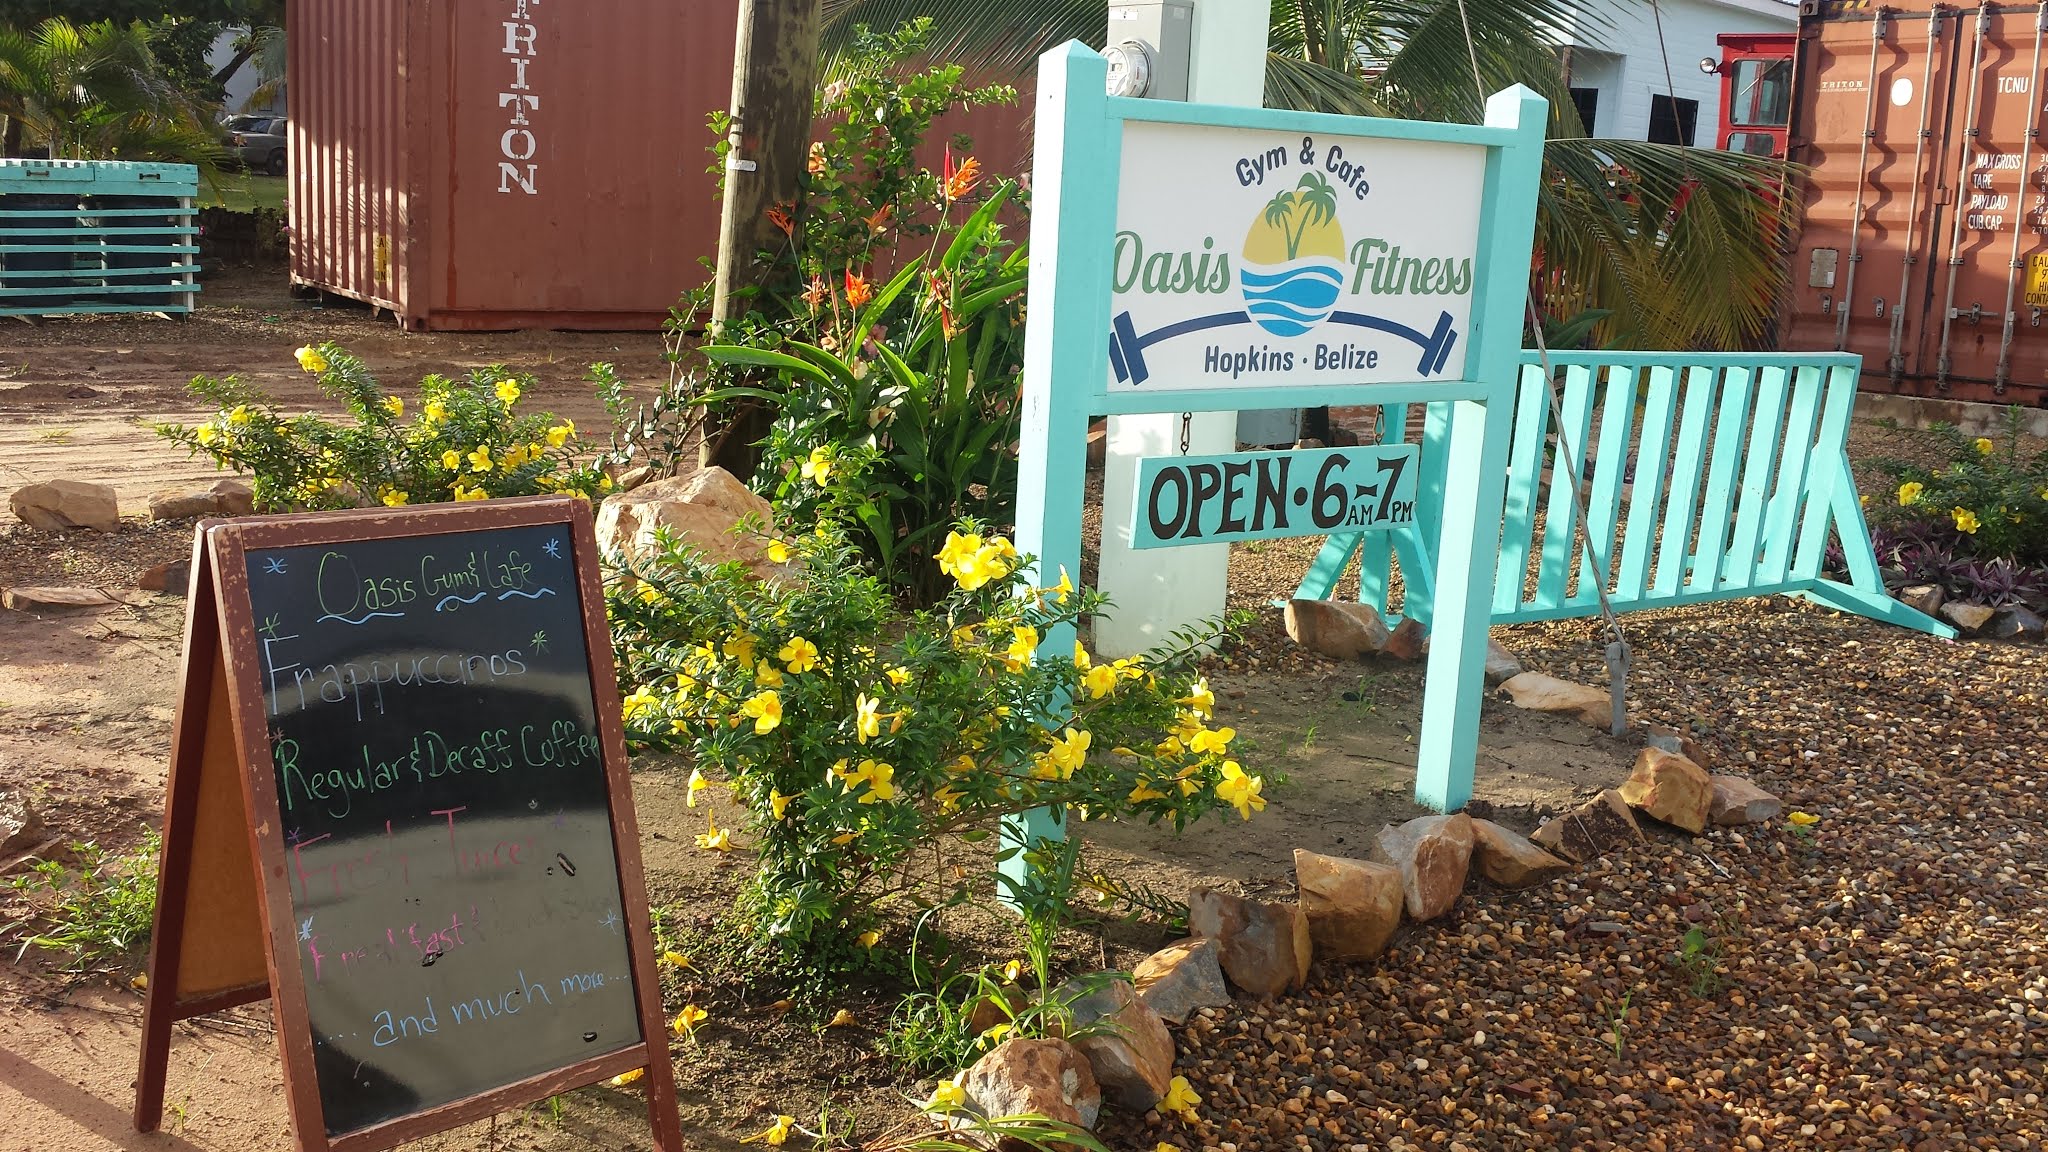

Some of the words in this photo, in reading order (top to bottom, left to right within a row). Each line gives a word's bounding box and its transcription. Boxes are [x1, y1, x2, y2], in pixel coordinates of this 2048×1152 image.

[498, 0, 540, 194] TRITON
[1822, 81, 1863, 89] TRITON
[1998, 76, 2029, 93] TCNU
[1235, 146, 1288, 187] Gym
[1299, 136, 1315, 165] &
[1325, 145, 1370, 201] Cafe
[1973, 174, 1993, 189] TARE
[1975, 154, 1996, 169] MAX
[1994, 154, 2022, 169] GROSS
[1970, 195, 2009, 210] PAYLOAD
[1112, 230, 1230, 295] Oasis
[1349, 237, 1472, 296] Fitness
[1204, 344, 1294, 379] Hopkins
[1314, 343, 1378, 371] Belize
[1149, 456, 1292, 540] OPEN
[317, 551, 417, 616] Oasis
[263, 634, 527, 722] Frappuccinos
[275, 738, 406, 819] Regular
[422, 729, 513, 777] Decaff
[521, 719, 600, 768] Coffee
[372, 996, 439, 1048] and
[451, 969, 553, 1025] much
